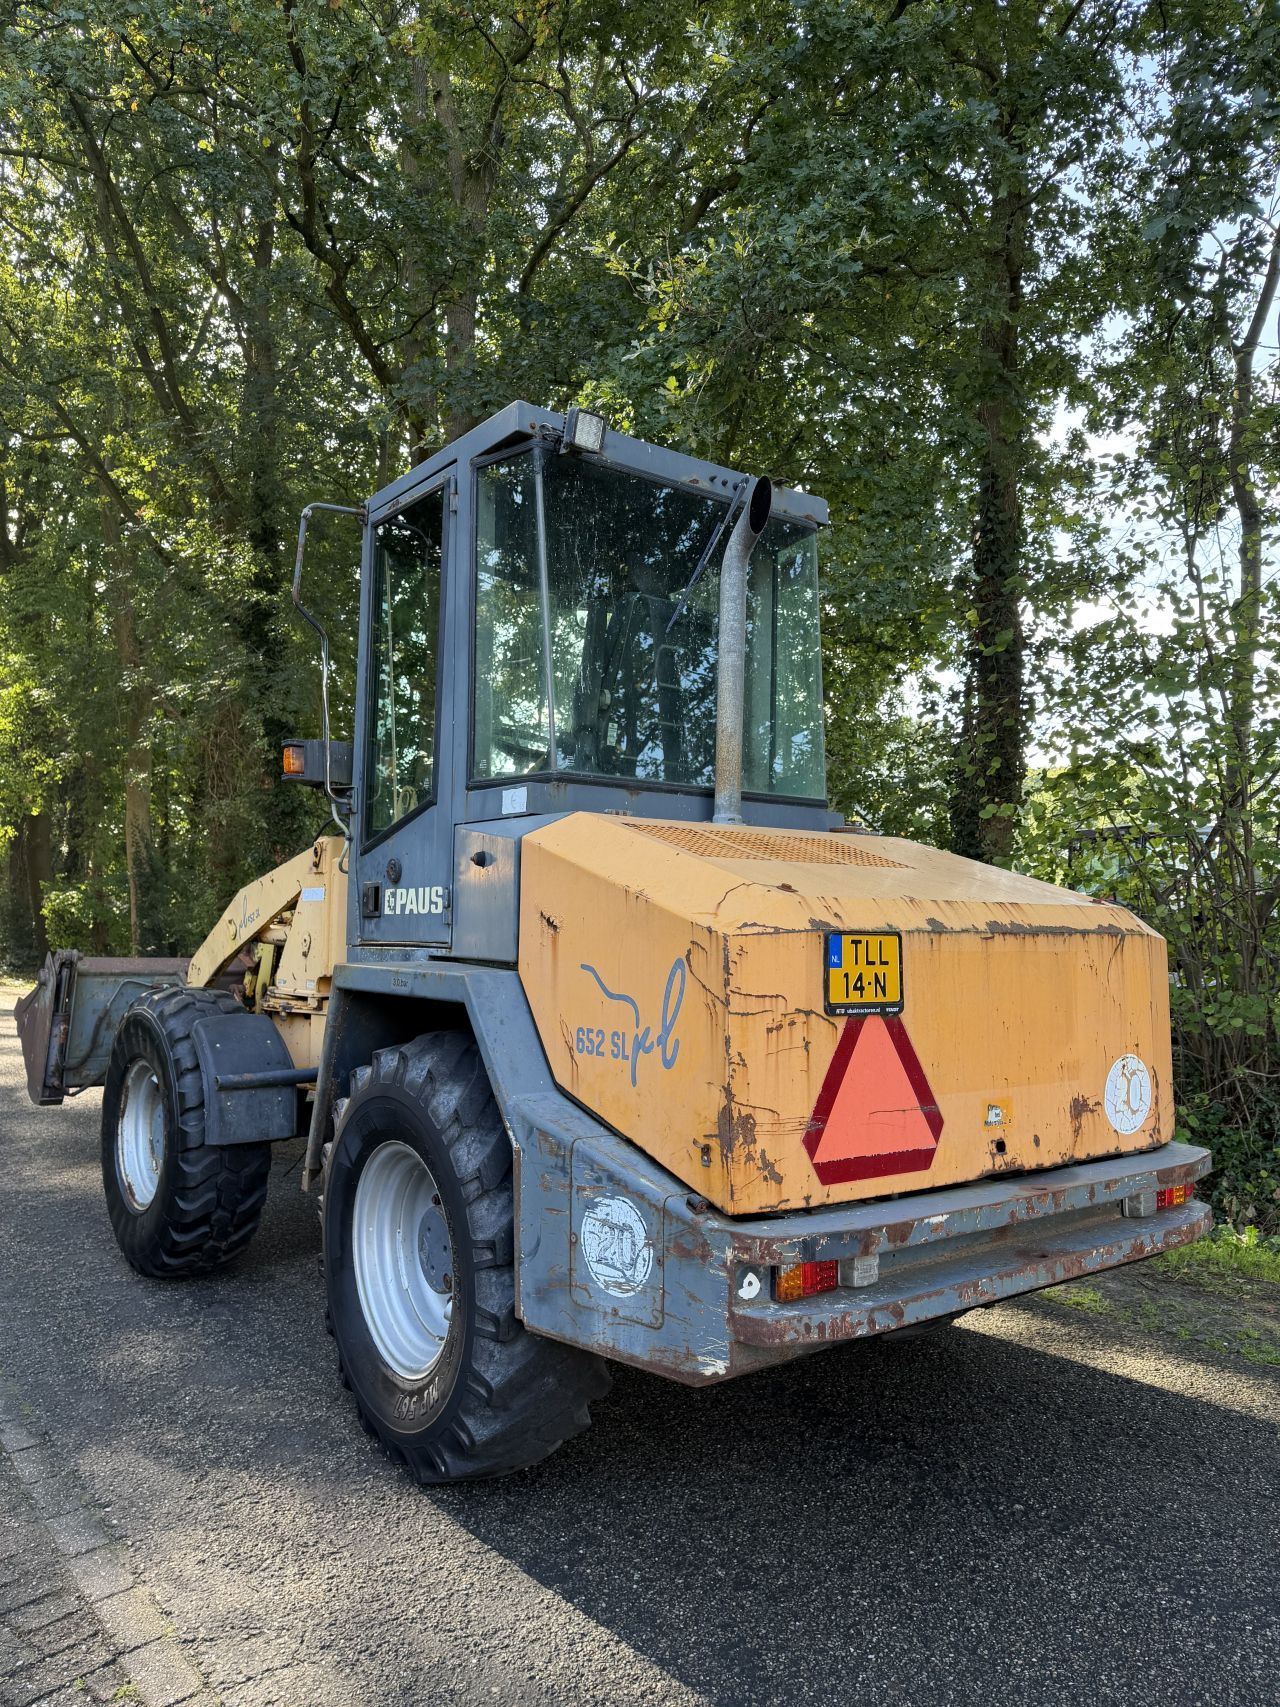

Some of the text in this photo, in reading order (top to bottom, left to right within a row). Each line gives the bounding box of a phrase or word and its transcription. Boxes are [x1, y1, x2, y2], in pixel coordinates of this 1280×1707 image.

[395, 887, 443, 914] PAUS
[831, 955, 840, 963] NL
[850, 940, 889, 966] TLL
[576, 1026, 630, 1061] 652 SL
